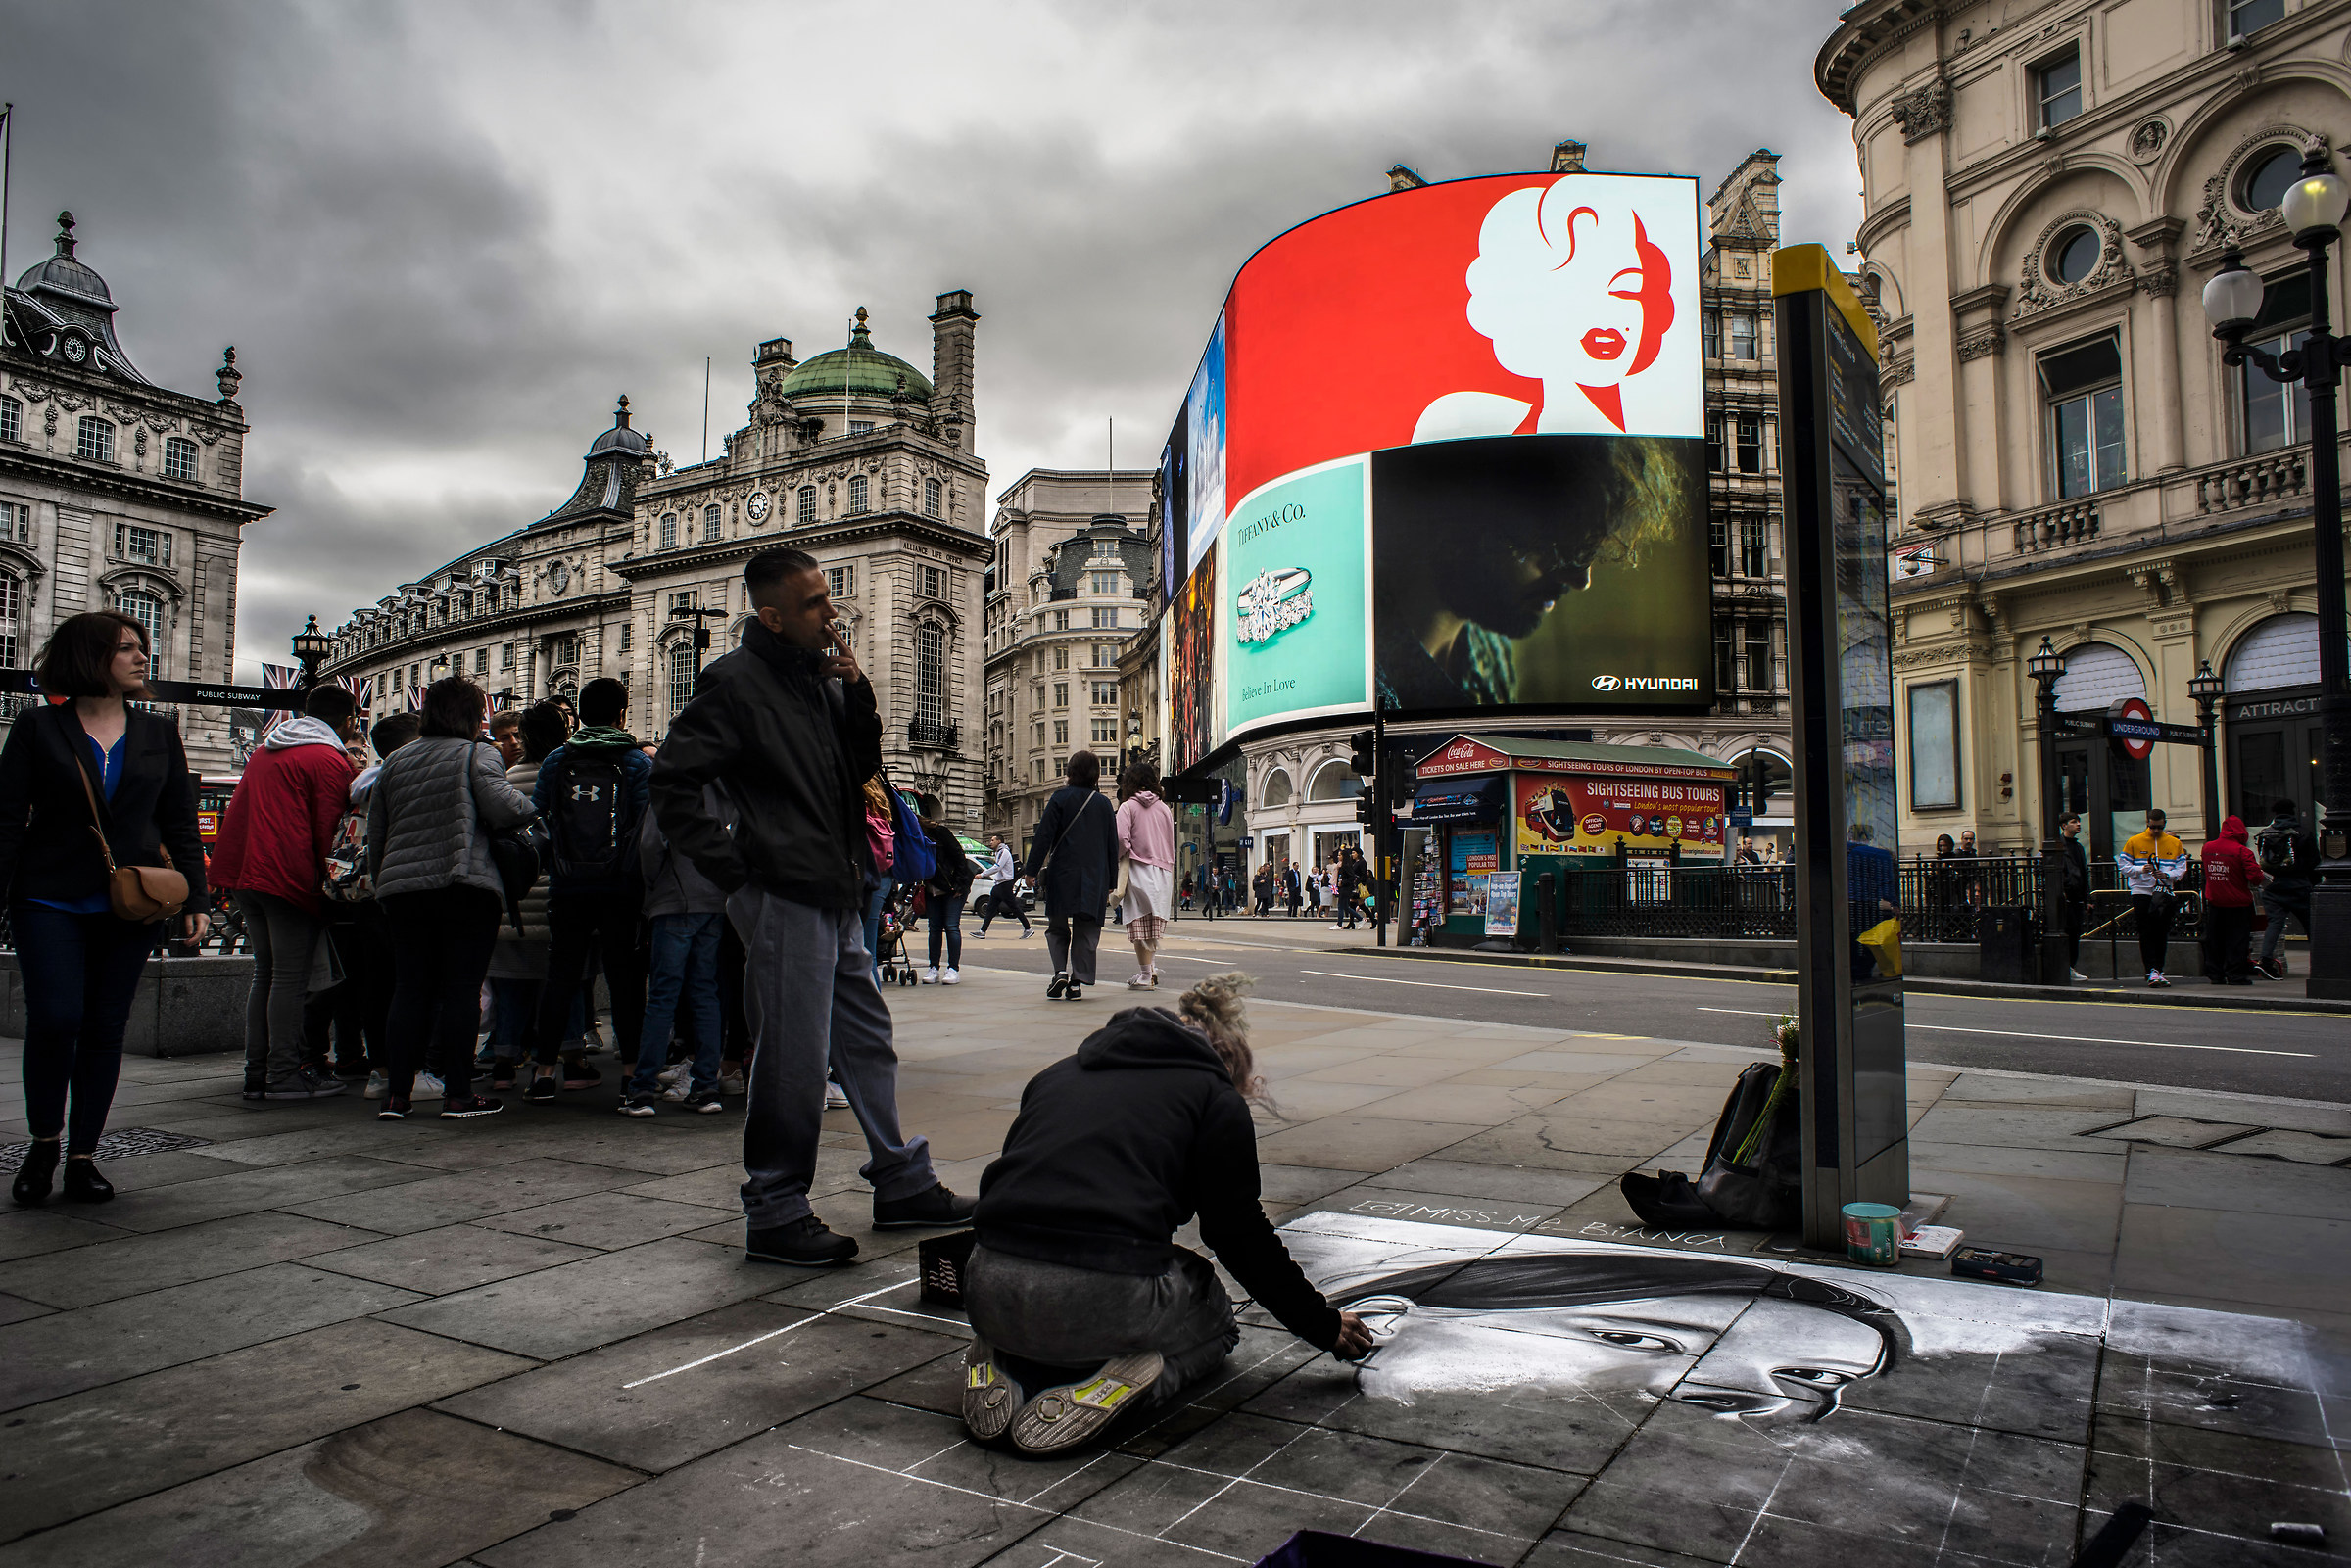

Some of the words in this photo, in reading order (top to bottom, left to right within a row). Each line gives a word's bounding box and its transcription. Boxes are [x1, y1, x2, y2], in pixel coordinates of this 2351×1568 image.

[1238, 515, 1271, 548] TIFFANY
[1242, 686, 1262, 702] Believe
[1263, 681, 1272, 695] In
[1273, 677, 1296, 692] Love
[1624, 677, 1698, 690] HYUNDAI
[196, 690, 226, 699] PUBLIC
[227, 692, 261, 701] SUBWAY
[2239, 697, 2321, 718] ATTRACT
[2064, 719, 2079, 727] PUBLIC
[2113, 722, 2160, 736] UNDERGROUND
[1422, 763, 1444, 774] TICKETS
[1455, 762, 1470, 771] SALE
[1470, 760, 1485, 768] HERE
[1547, 760, 1591, 770] SIGHTSEEING
[1592, 763, 1614, 771] TOURS
[1626, 764, 1653, 773] LONDON
[1654, 766, 1663, 774] BY
[1664, 767, 1694, 776] OPEN-TOP
[1586, 782, 1659, 799] SIGHTSEEING
[1662, 786, 1683, 800] BUS
[1685, 787, 1720, 802] TOURS
[1634, 802, 1662, 811] London's
[1663, 803, 1678, 811] most
[1679, 803, 1703, 813] popular
[1704, 804, 1720, 813] tour!
[2208, 864, 2229, 873] LONDON
